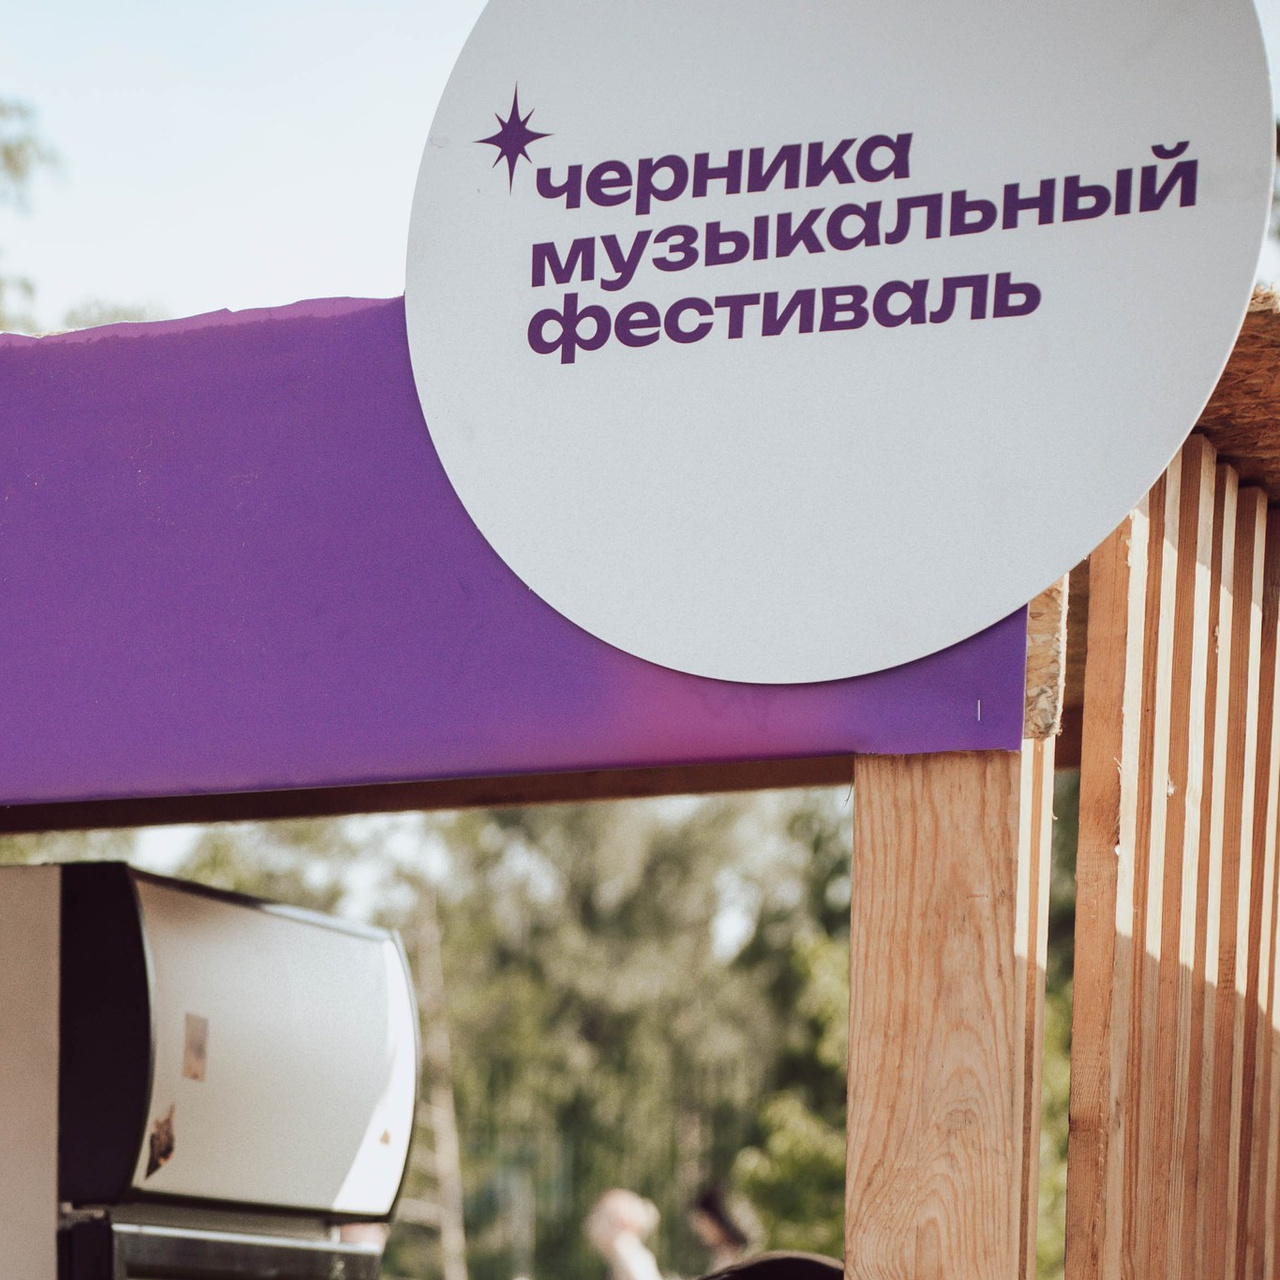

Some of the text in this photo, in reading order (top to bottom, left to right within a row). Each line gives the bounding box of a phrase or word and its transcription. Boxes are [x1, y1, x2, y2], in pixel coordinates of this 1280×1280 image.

[531, 140, 1199, 288] музыкальный
[536, 132, 913, 216] черника
[527, 271, 1042, 365] фестиваль
